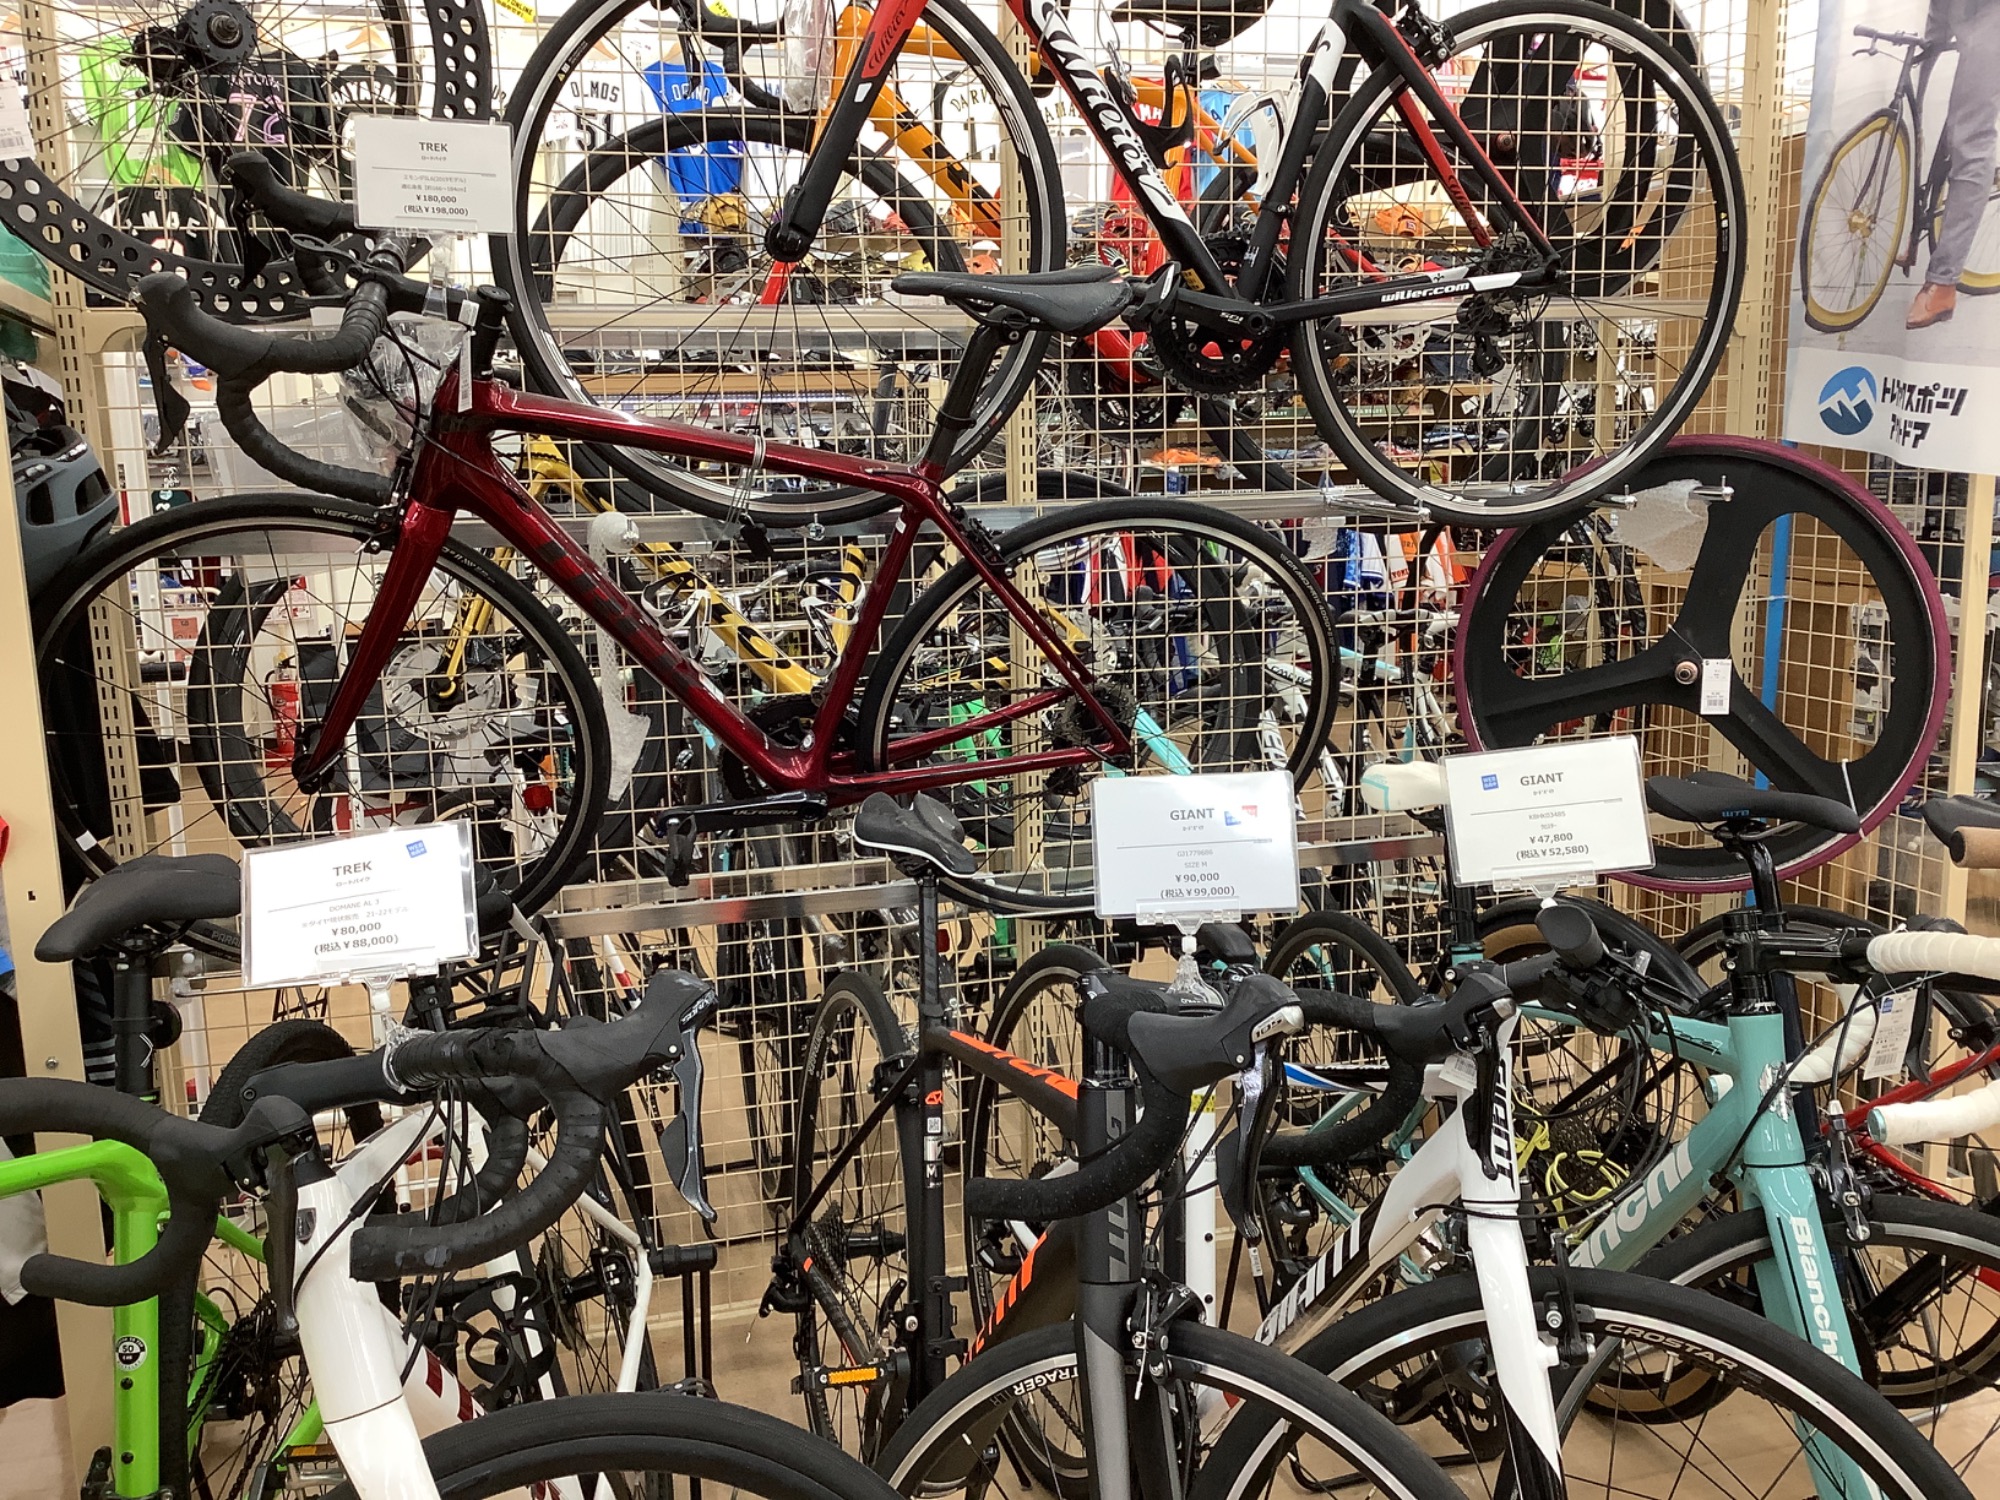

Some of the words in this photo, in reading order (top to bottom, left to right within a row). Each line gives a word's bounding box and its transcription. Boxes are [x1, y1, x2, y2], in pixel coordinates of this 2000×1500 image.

[419, 141, 448, 153] TREK
[416, 194, 457, 204] ¥180,000
[1380, 282, 1470, 303] wilier.com
[1520, 772, 1564, 787] GIANT
[1170, 808, 1215, 821] GIANT
[1529, 832, 1573, 845] ¥47,800
[332, 861, 373, 877] TREK
[1175, 872, 1220, 884] ¥90,000
[331, 922, 382, 937] ¥80,000
[1604, 1323, 1739, 1370] CROSTAR
[1013, 1366, 1079, 1396] TRAGER
